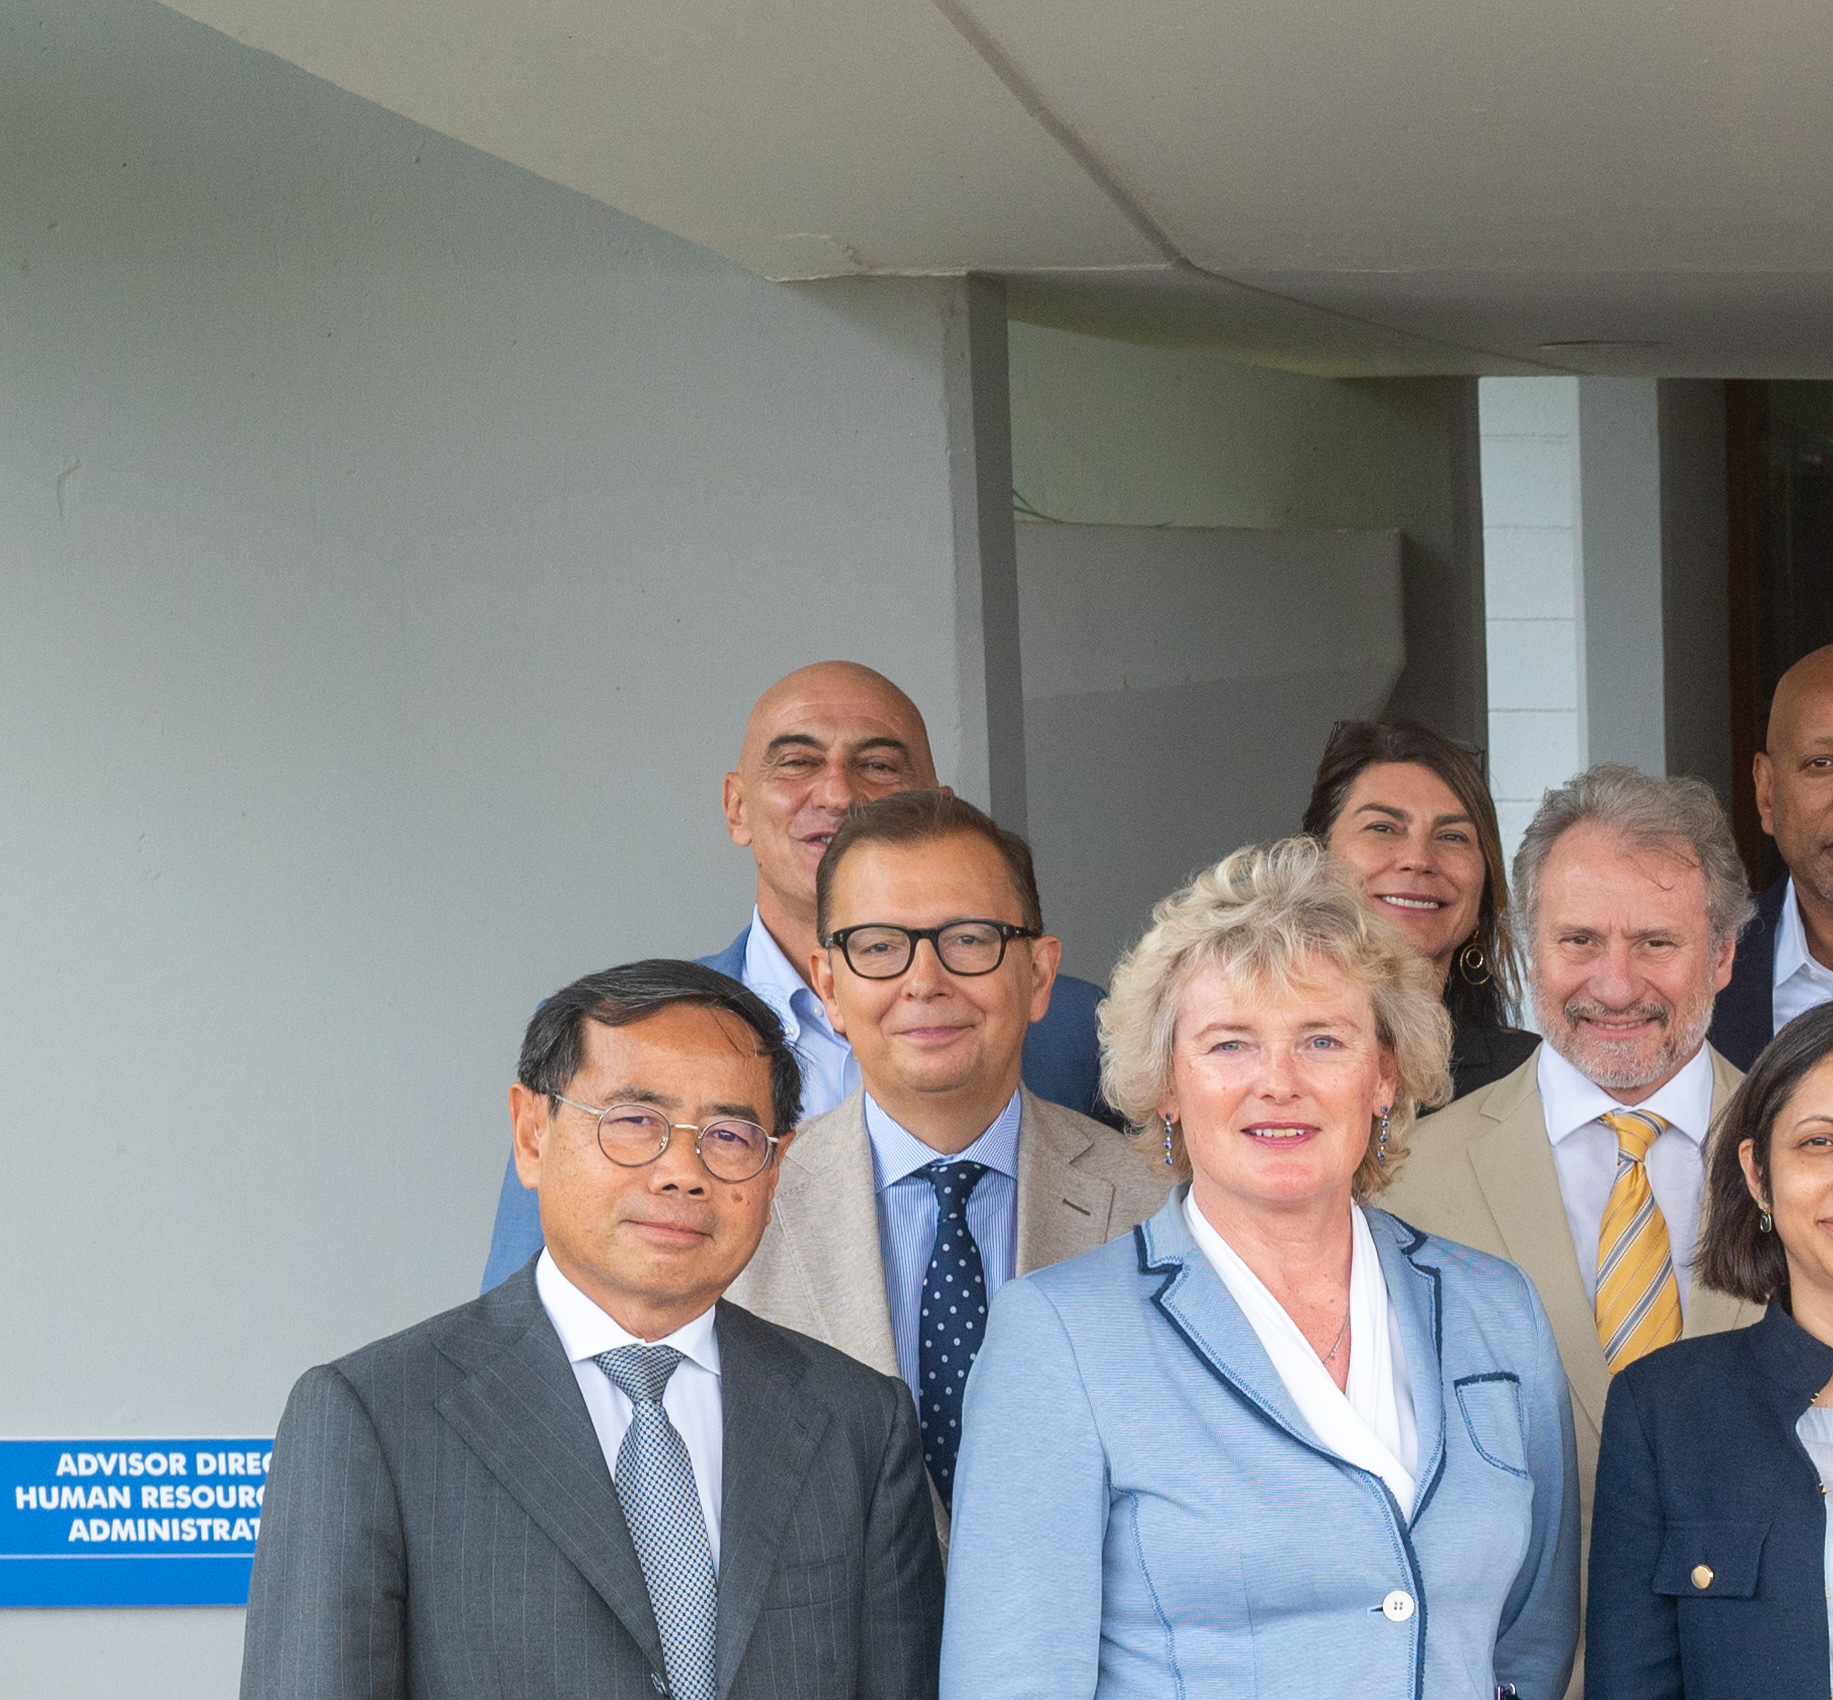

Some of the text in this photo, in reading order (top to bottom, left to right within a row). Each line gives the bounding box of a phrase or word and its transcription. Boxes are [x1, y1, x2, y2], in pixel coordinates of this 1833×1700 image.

[56, 1452, 187, 1476] ADVISOR
[15, 1485, 131, 1510] HUMAN
[68, 1517, 261, 1542] ADMINISTRAT
